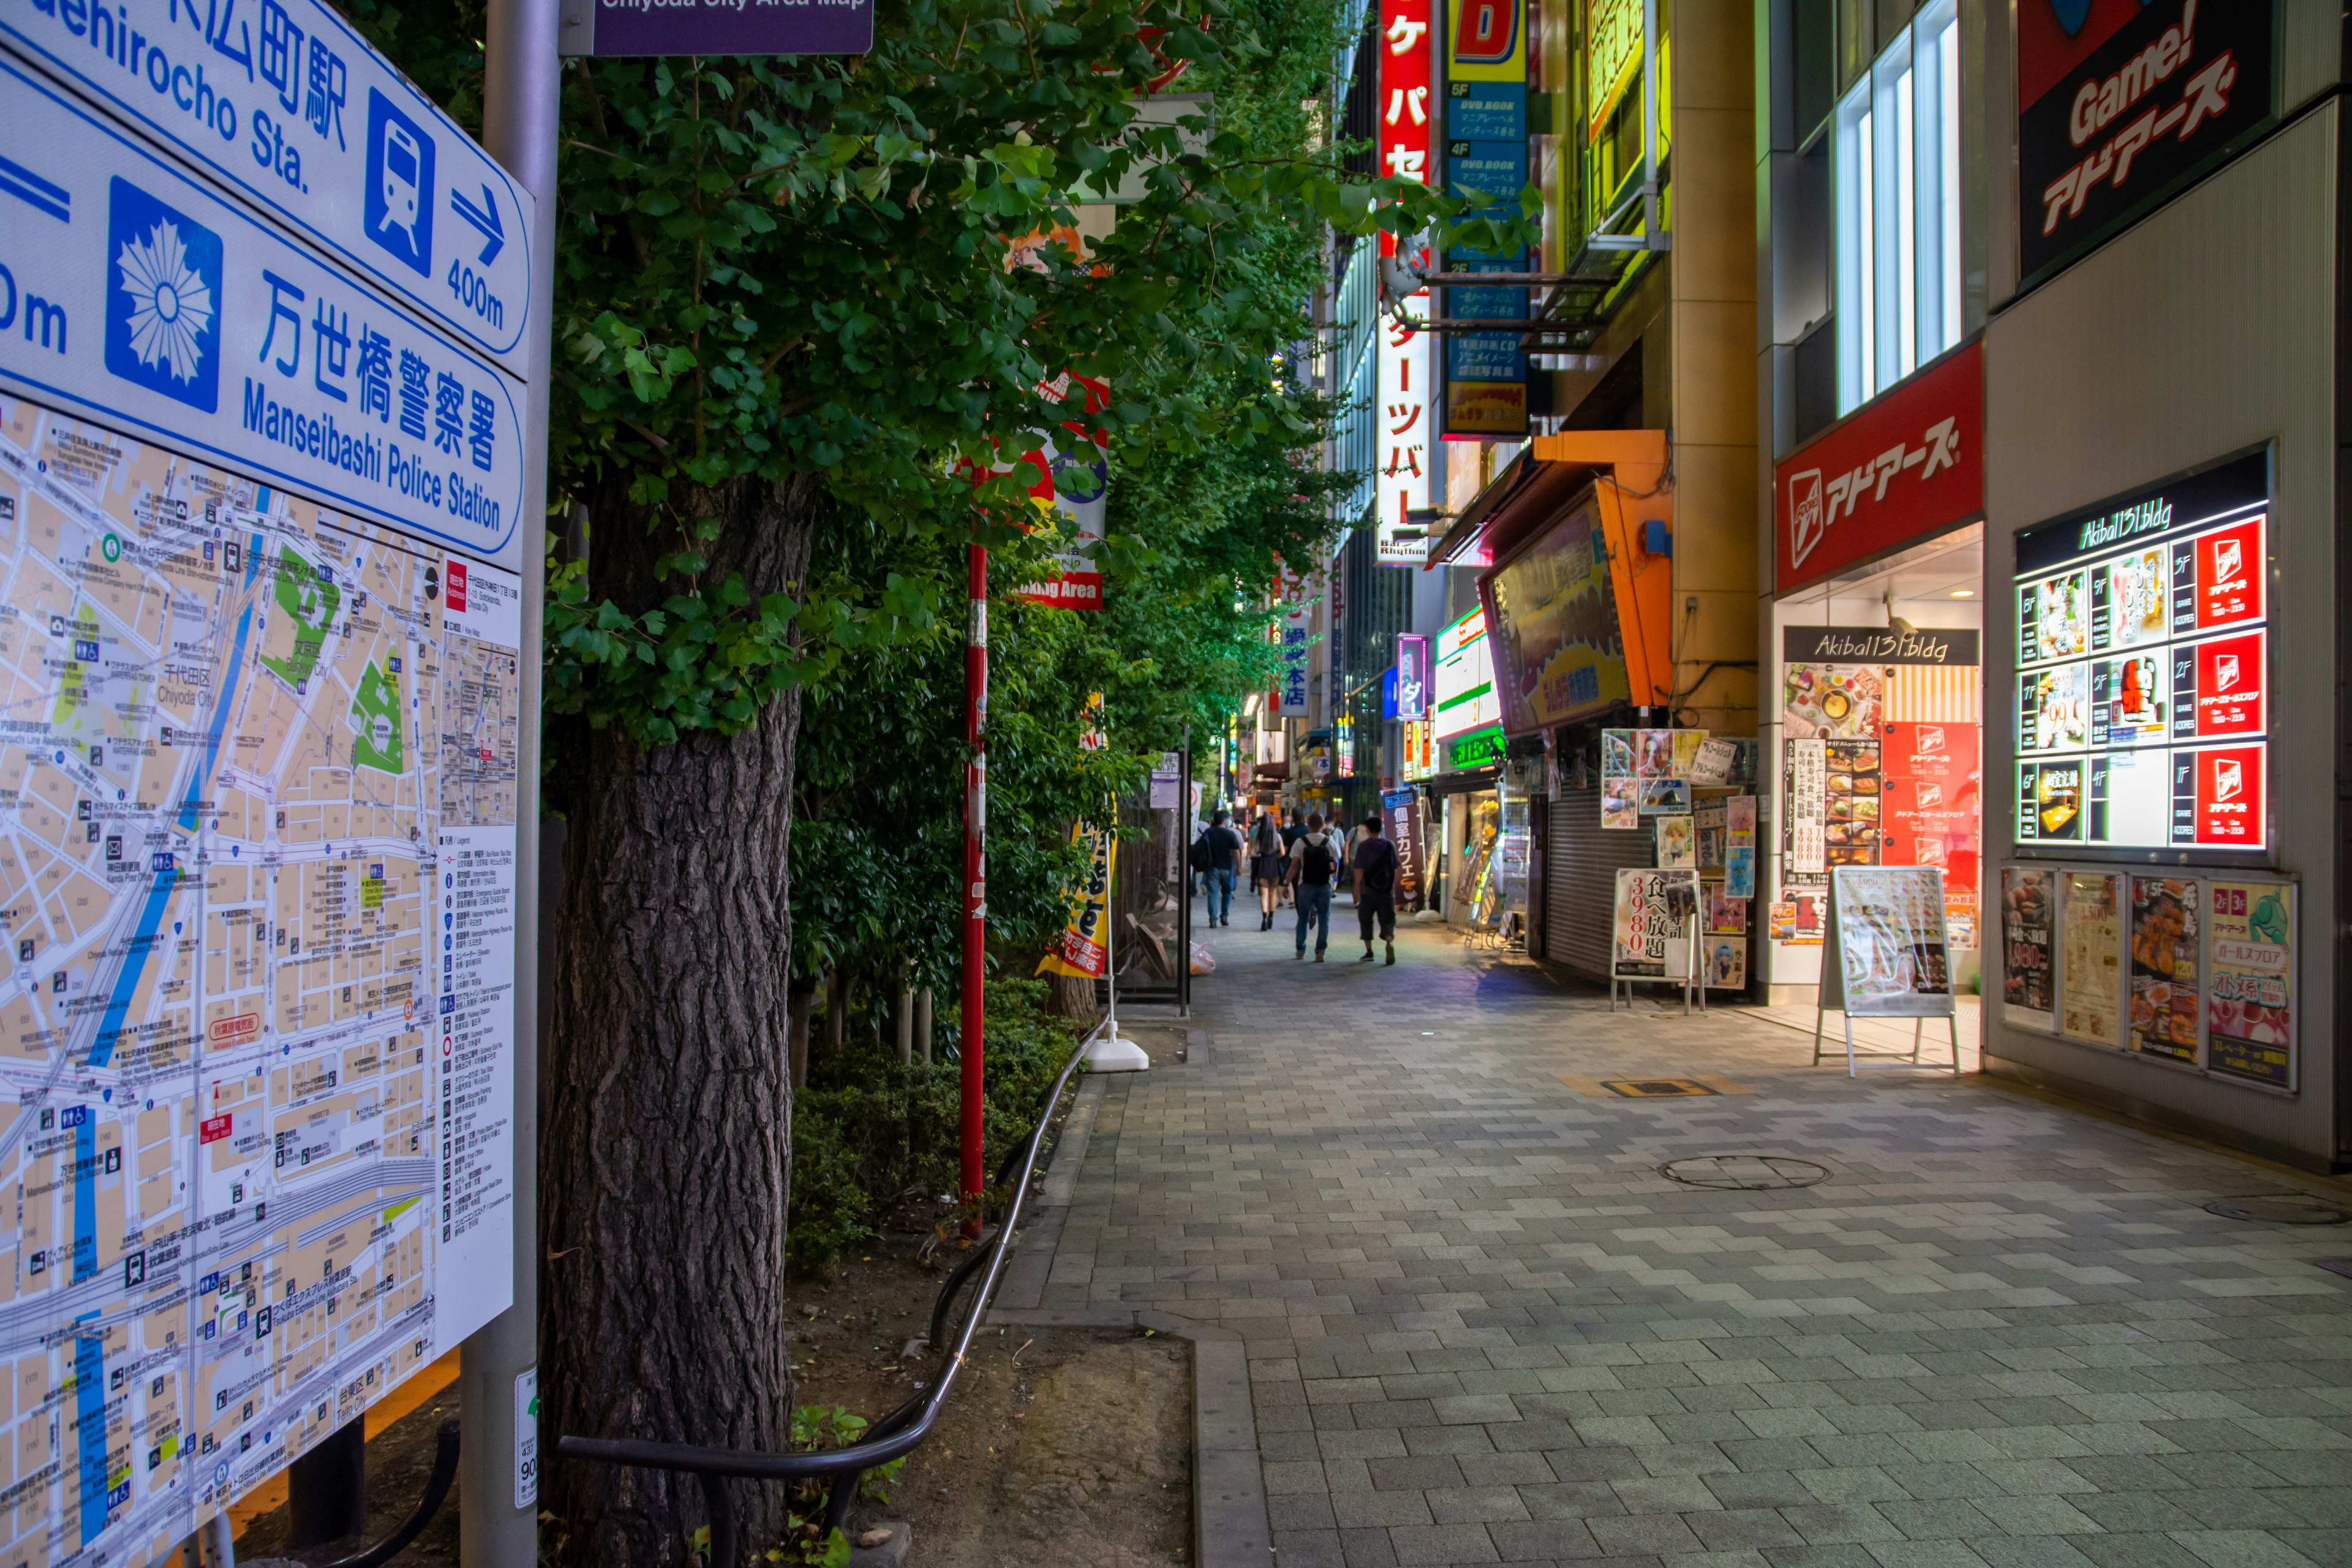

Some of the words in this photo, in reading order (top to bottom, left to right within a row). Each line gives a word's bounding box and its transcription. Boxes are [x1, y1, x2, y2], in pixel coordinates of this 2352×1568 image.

[2070, 0, 2199, 147] Game!
[1452, 84, 1468, 96] 5F
[251, 109, 308, 194] Sta.
[1452, 143, 1468, 155] 4F
[2043, 48, 2239, 236] アドアーズ
[448, 259, 503, 331] 400m
[260, 269, 496, 472] 万世橋警察署
[244, 377, 381, 483] Manseibashi
[389, 437, 442, 508] Police
[448, 469, 500, 532] Station
[1826, 415, 1959, 525] アドアーズ
[1381, 547, 1425, 556] Rhythm
[2174, 554, 2192, 575] 3F
[1061, 581, 1096, 598] Area
[2094, 578, 2107, 596] 9F
[2023, 597, 2036, 613] 8F
[2176, 598, 2192, 608] GAME
[2174, 613, 2195, 626] ADORES
[295, 639, 320, 658] 文京区
[164, 663, 211, 687] 千代田区
[287, 657, 312, 676] Bunkyo
[315, 662, 329, 680] City
[2175, 660, 2192, 679] 2F
[2024, 685, 2036, 700] 7F
[2094, 674, 2108, 692] 5F
[158, 685, 195, 708] Chiyoda
[198, 688, 216, 710] City
[2174, 719, 2195, 730] ADORES
[1806, 750, 1815, 818] 本格寿司食べ放題
[2023, 774, 2035, 789] 6F
[2092, 771, 2107, 786] 4F
[2176, 766, 2190, 784] 1F
[1796, 750, 1806, 820] 寿司しゃぶ食べ放題
[1815, 750, 1824, 826] しゃぶしゃぶ食べ放題
[2176, 809, 2192, 818] GAME
[2173, 825, 2194, 835] ADORES
[457, 836, 470, 845] Legend
[1395, 807, 1414, 877] 個室カフェ
[2150, 881, 2165, 897] 5F
[1943, 894, 1977, 904] 飲み放題
[2215, 892, 2227, 910] 2F
[2232, 895, 2245, 912] 3F
[1630, 876, 1645, 951] 3980
[1645, 876, 1667, 959] 食べ放題
[214, 1019, 254, 1037] 秋葉原電気街
[201, 1134, 210, 1144] You
[221, 1128, 230, 1137] here
[26, 1180, 64, 1198] Manseibashi
[149, 1245, 181, 1268] 秋葉原駅
[273, 1309, 294, 1327] Tsukuba
[316, 1291, 325, 1305] Line
[339, 1376, 364, 1406] 台東区
[337, 1404, 353, 1423] Taito
[353, 1393, 368, 1414] City
[521, 1444, 534, 1457] 437
